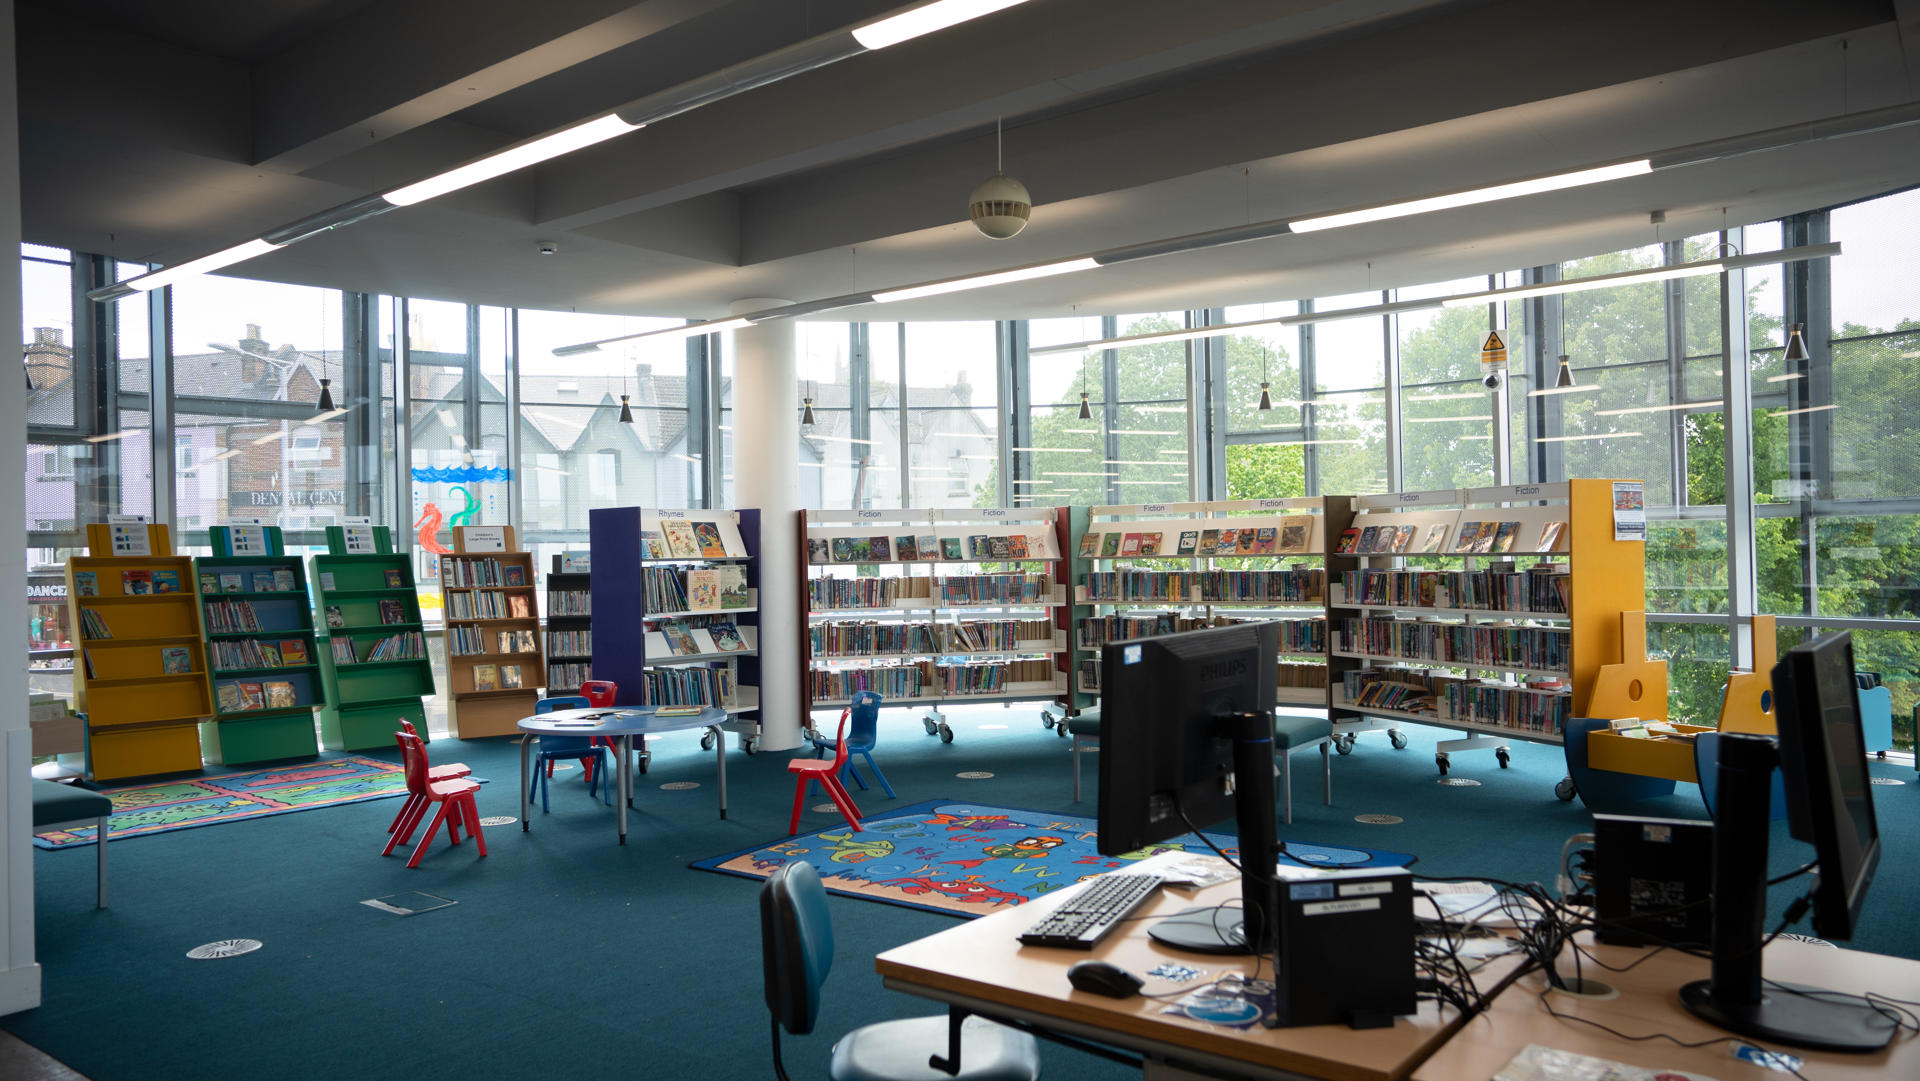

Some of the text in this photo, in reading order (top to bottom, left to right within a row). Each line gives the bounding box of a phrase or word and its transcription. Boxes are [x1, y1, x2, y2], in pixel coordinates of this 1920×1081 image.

[1515, 487, 1540, 496] Fiction
[251, 491, 306, 505] DENAL
[1399, 493, 1420, 502] Fiction
[1143, 504, 1165, 512] Fiction
[1260, 499, 1284, 508] Fiction
[658, 509, 685, 519] Rhymes
[858, 510, 882, 518] Fiction
[983, 509, 1006, 517] Fiction
